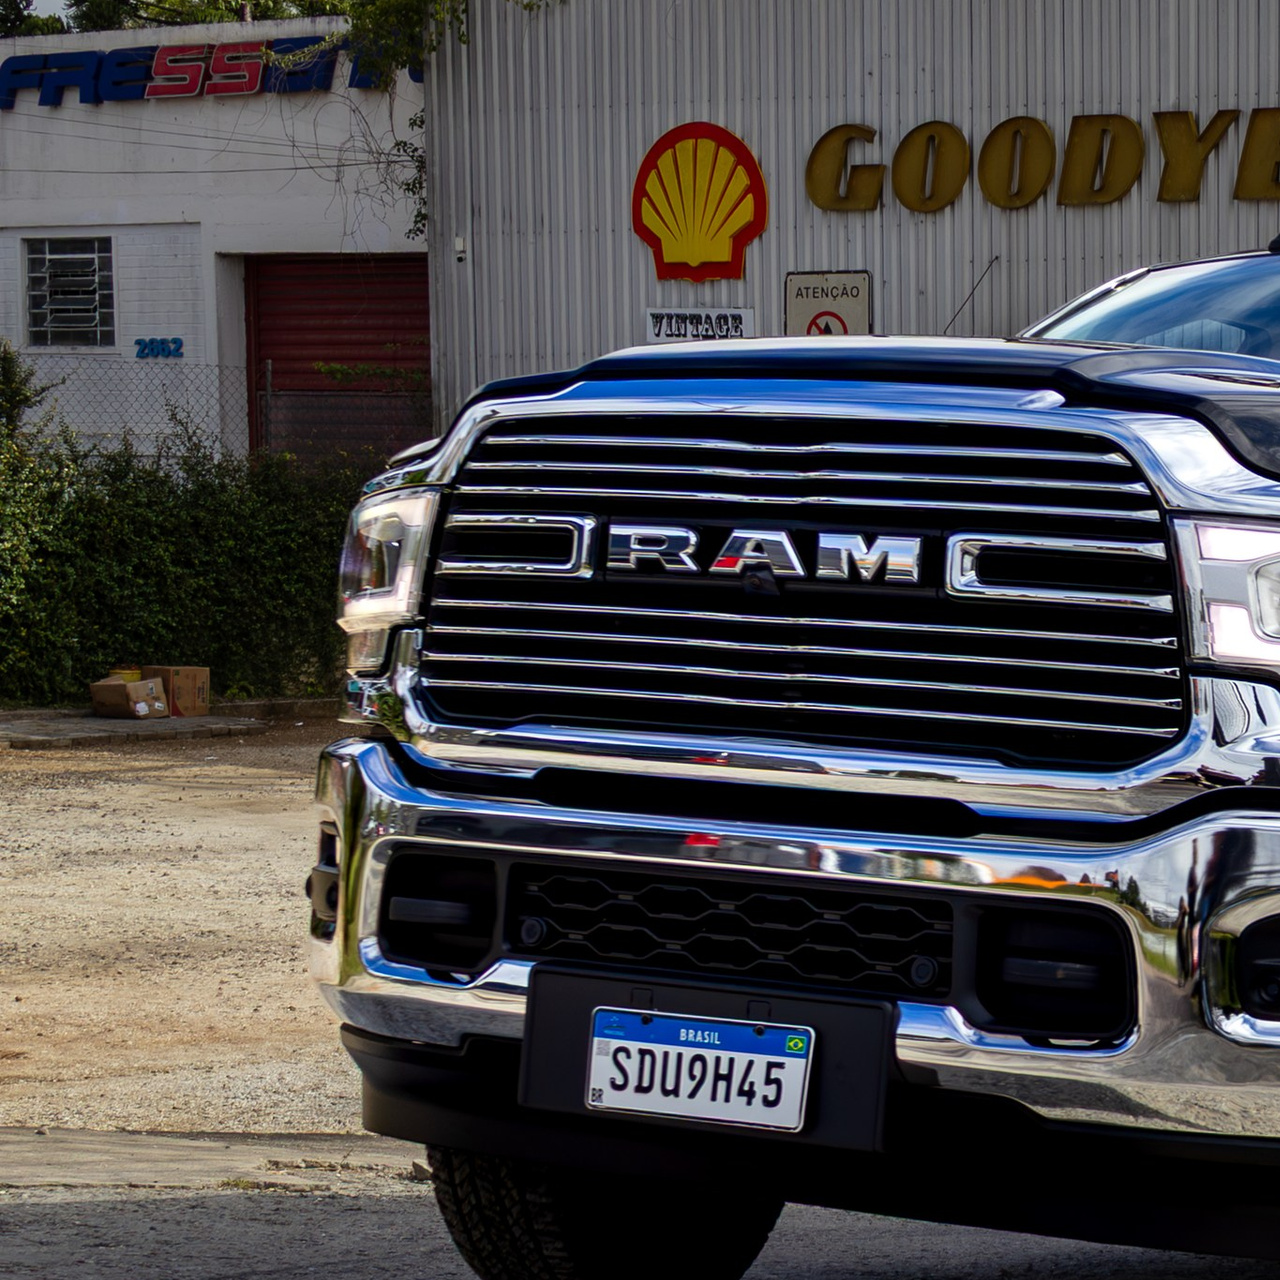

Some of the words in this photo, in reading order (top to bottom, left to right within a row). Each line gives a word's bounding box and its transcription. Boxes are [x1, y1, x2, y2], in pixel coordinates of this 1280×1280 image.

[795, 283, 860, 301] ATENÇÃO
[650, 312, 744, 339] VINTAGE
[134, 337, 184, 359] 2662
[606, 523, 923, 584] RAM
[680, 1028, 721, 1045] BRASIL
[609, 1045, 787, 1109] SDU9H45
